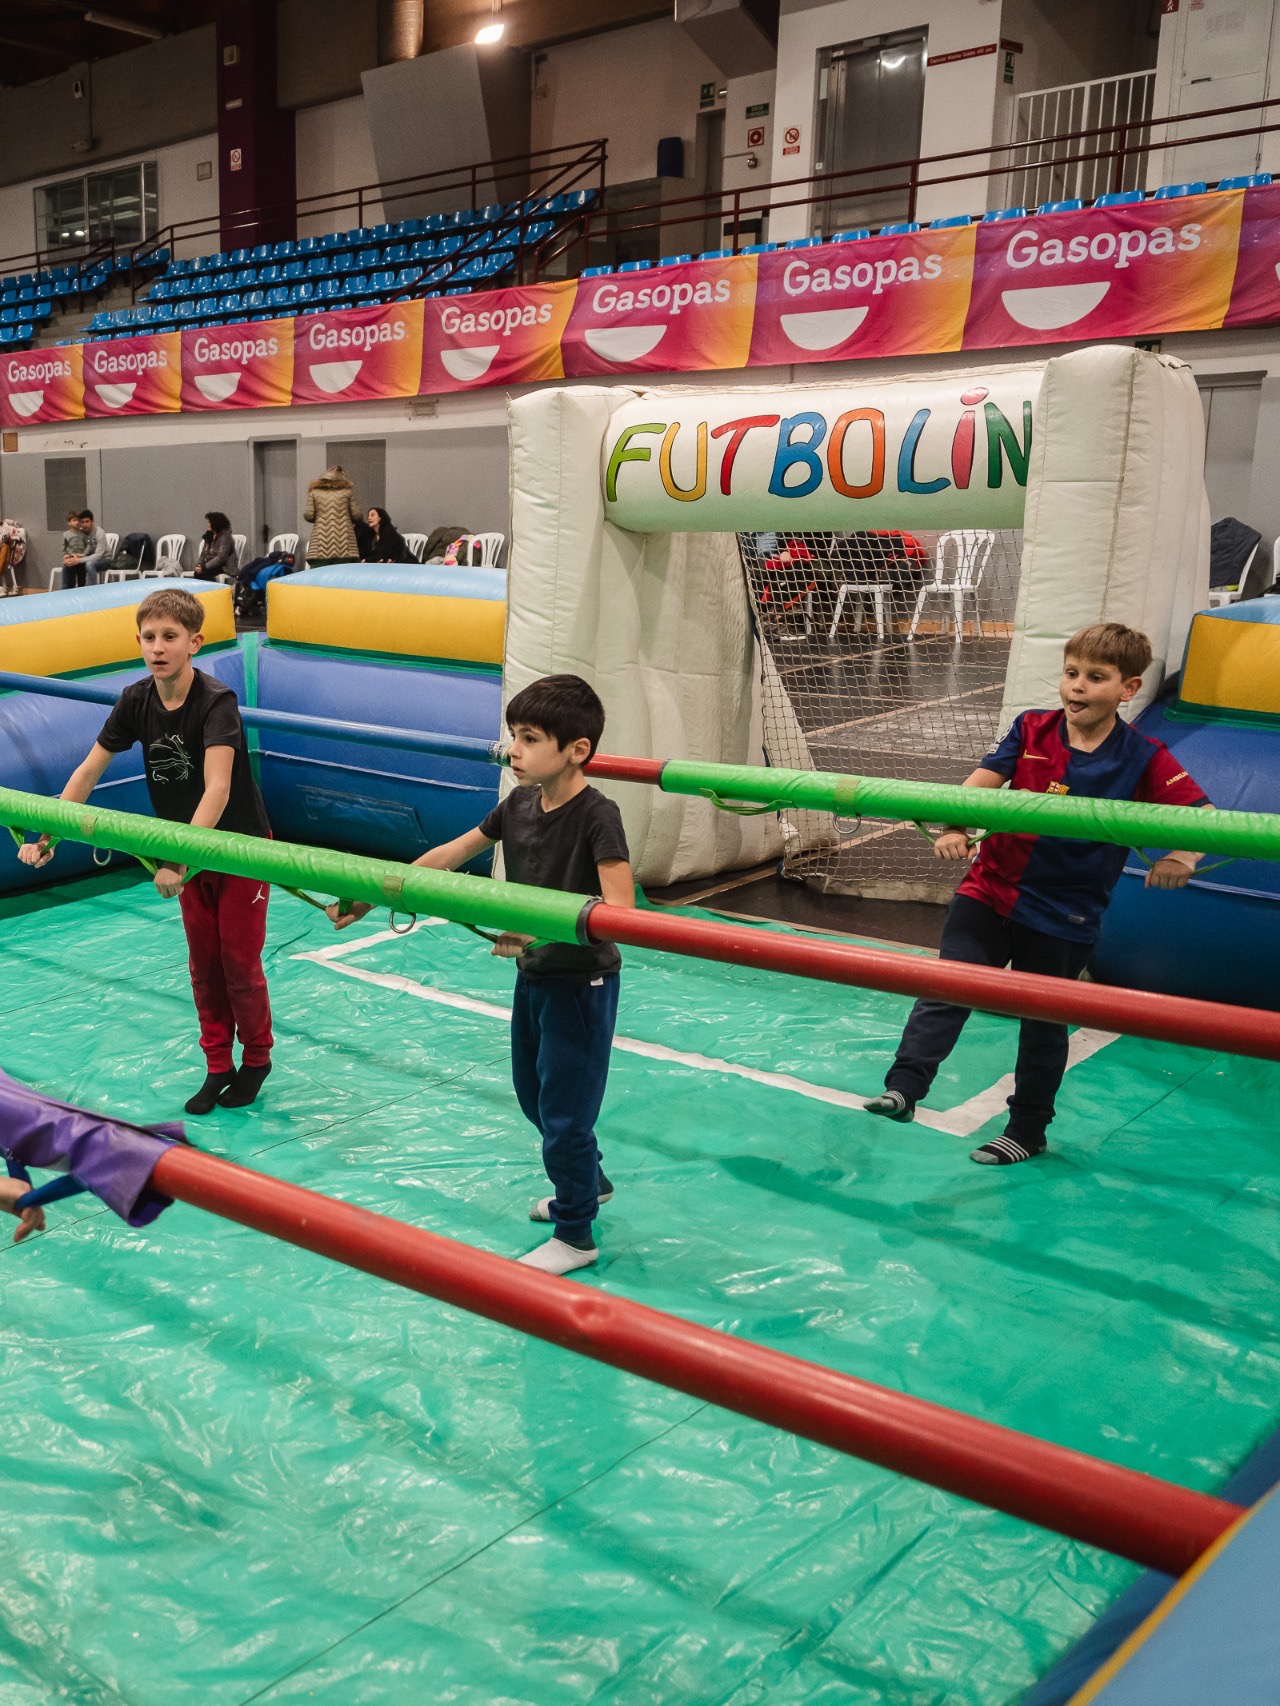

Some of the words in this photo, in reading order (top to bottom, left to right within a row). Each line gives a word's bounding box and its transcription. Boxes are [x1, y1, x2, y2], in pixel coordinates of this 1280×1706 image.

[1005, 222, 1202, 270] Gasopas
[782, 253, 943, 296] Gasopas
[592, 279, 731, 315] Gasopas
[309, 320, 406, 352] Gasopas
[440, 303, 553, 337] Gasopas
[94, 350, 168, 376] Gasopas
[194, 335, 278, 366] Gasopas
[8, 360, 72, 384] Gasopas
